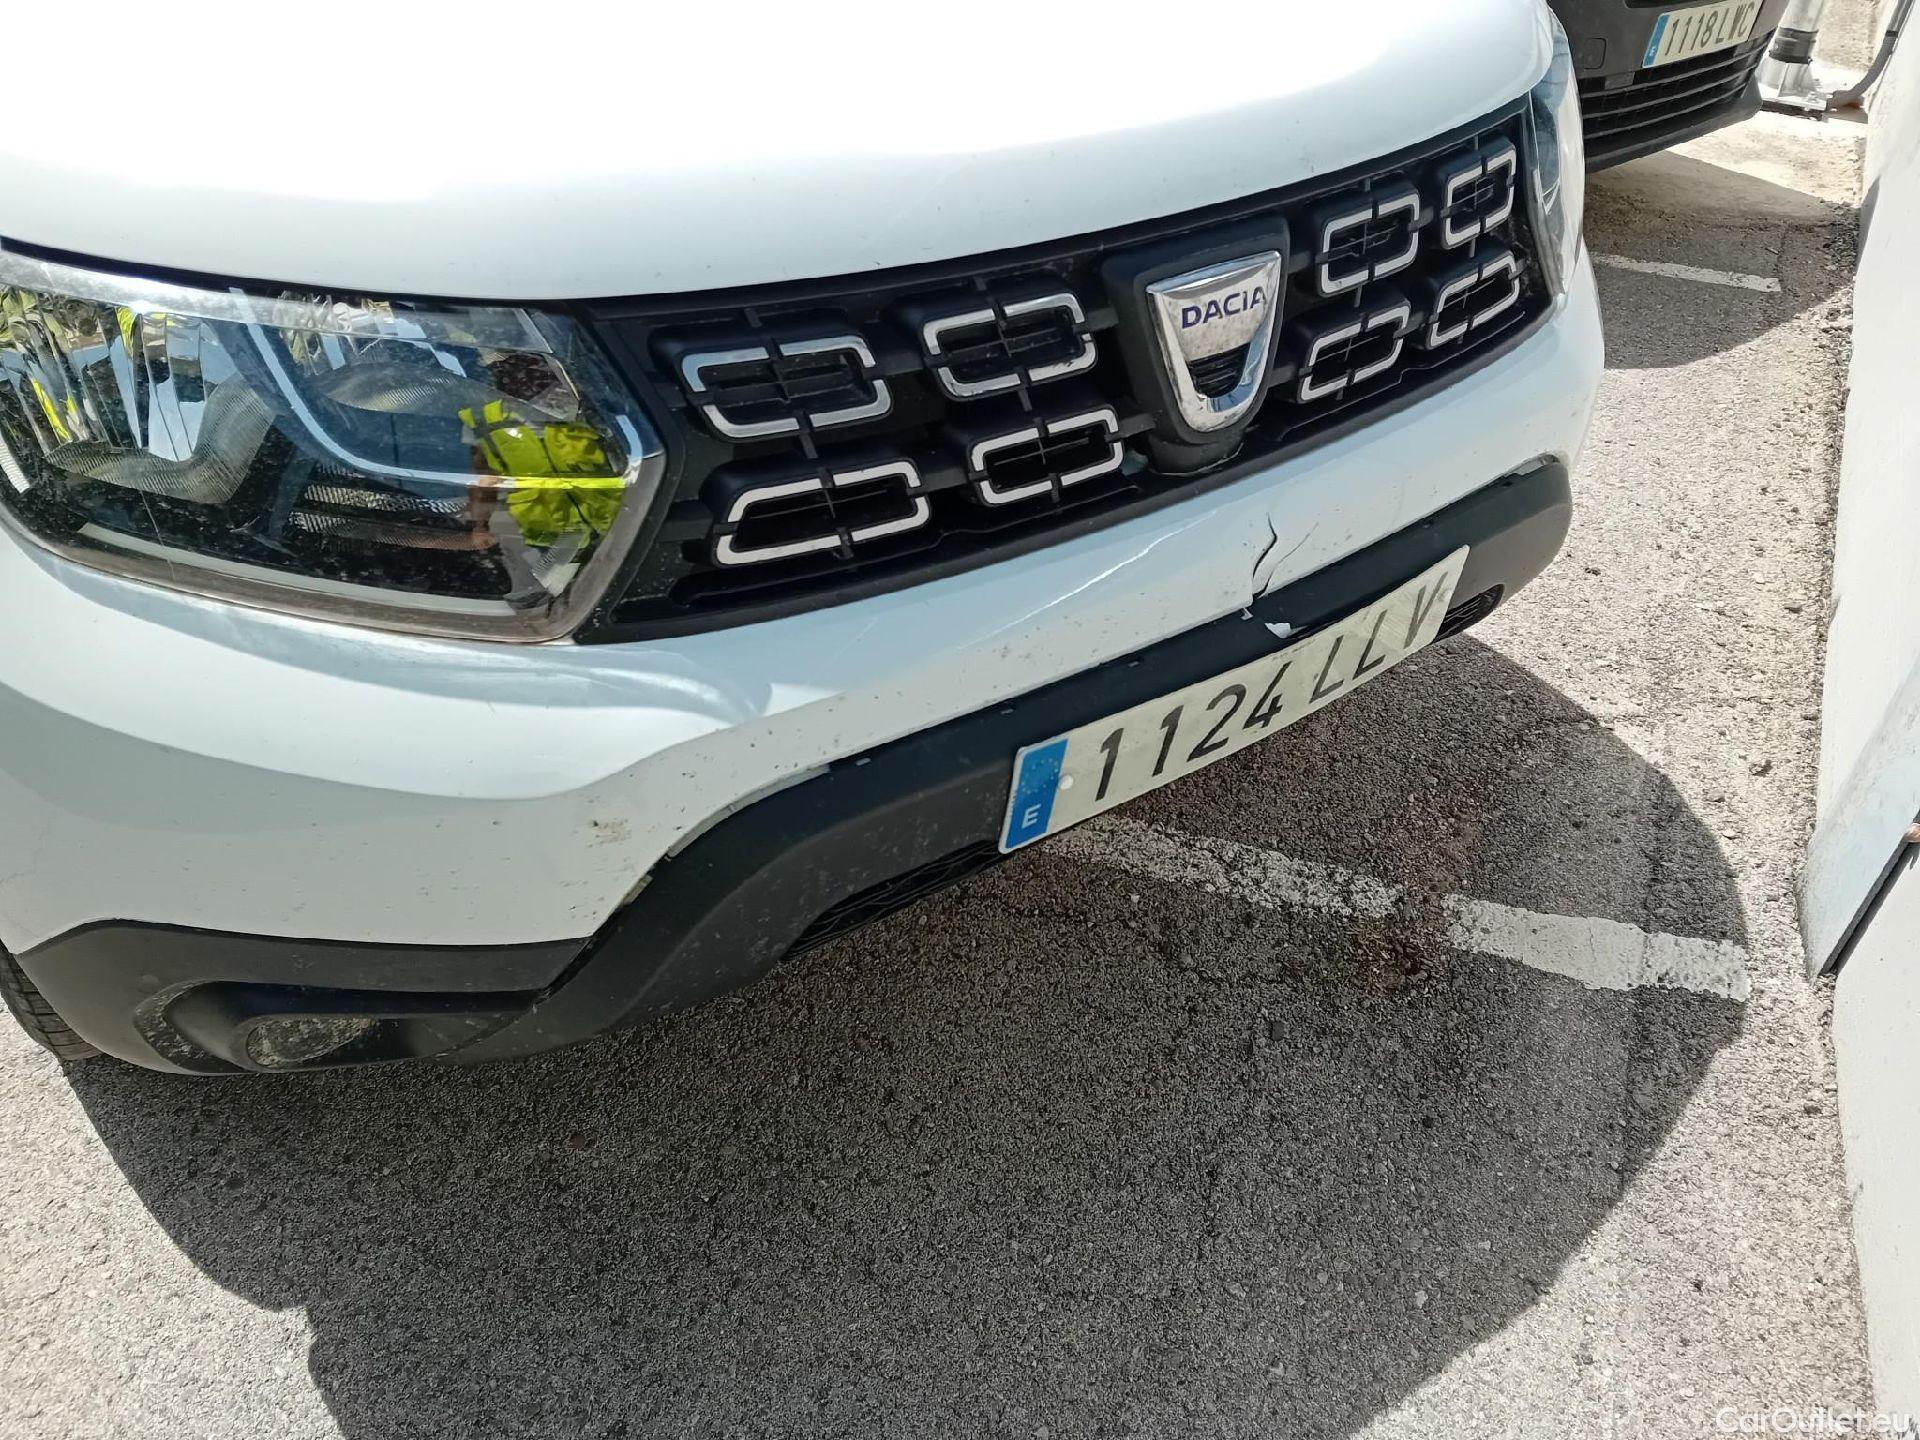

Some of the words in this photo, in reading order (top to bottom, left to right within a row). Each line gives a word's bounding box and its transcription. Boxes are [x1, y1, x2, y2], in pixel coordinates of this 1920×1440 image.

[1665, 10, 1718, 56] 1118
[1182, 286, 1268, 329] DACIA
[1021, 803, 1041, 829] E
[1095, 661, 1293, 802] 1124
[1311, 571, 1448, 702] LLV
